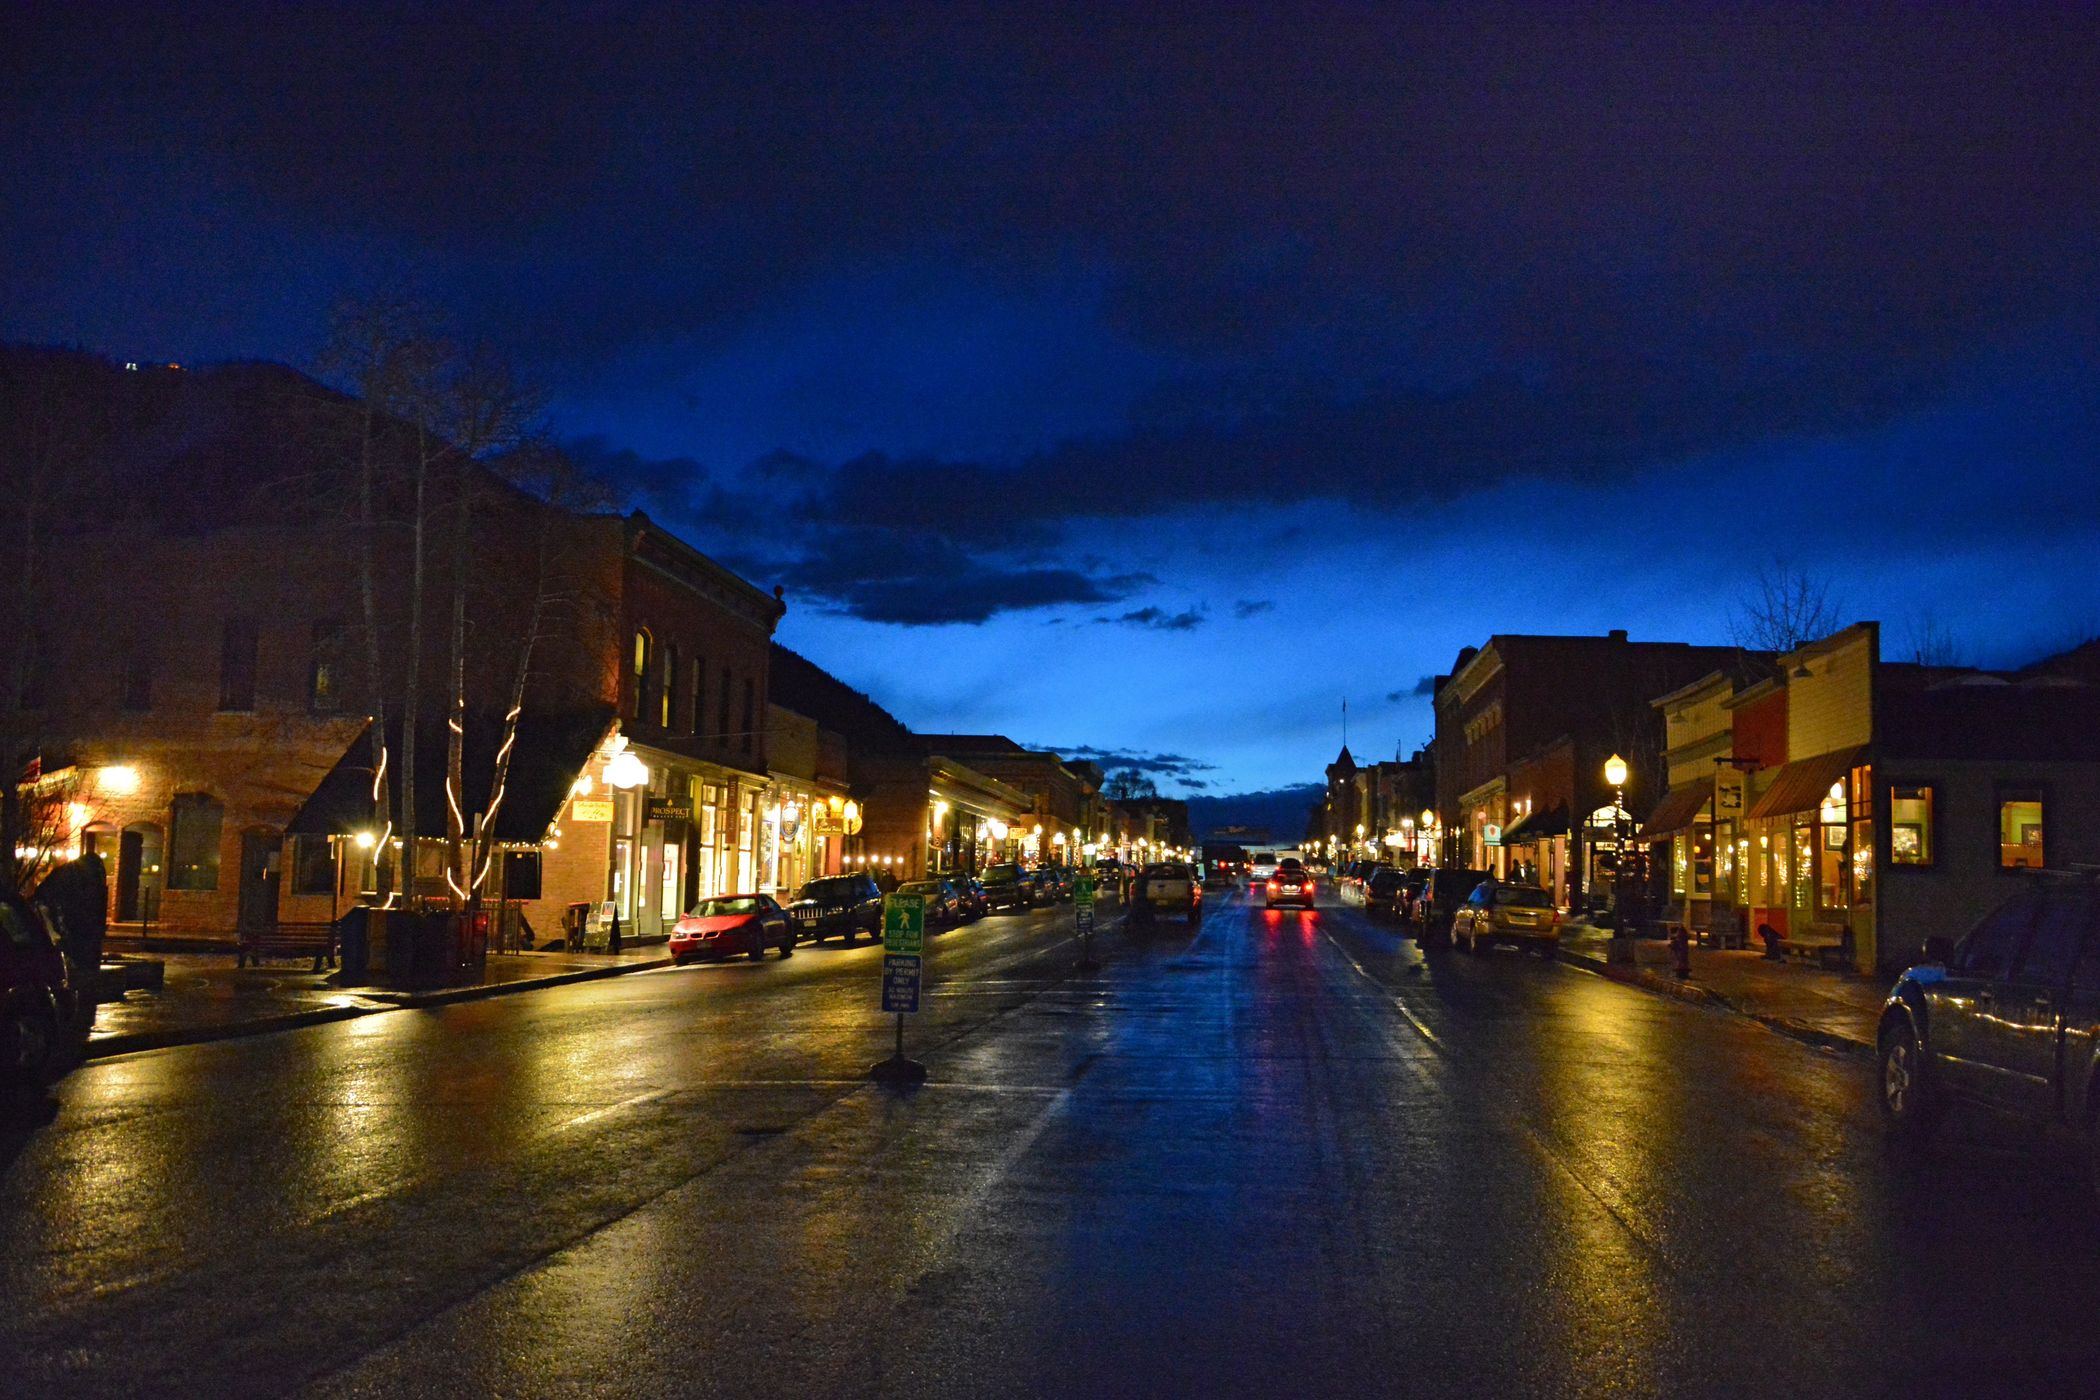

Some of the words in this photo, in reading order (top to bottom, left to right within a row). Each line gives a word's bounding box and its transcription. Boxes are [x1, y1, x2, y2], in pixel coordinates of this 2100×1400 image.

[651, 807, 690, 818] PROSPECT
[887, 898, 920, 908] PLEASE
[888, 959, 916, 967] PARKING
[884, 967, 893, 976] BY
[895, 968, 920, 976] PERMIT
[893, 976, 910, 985] ONLY
